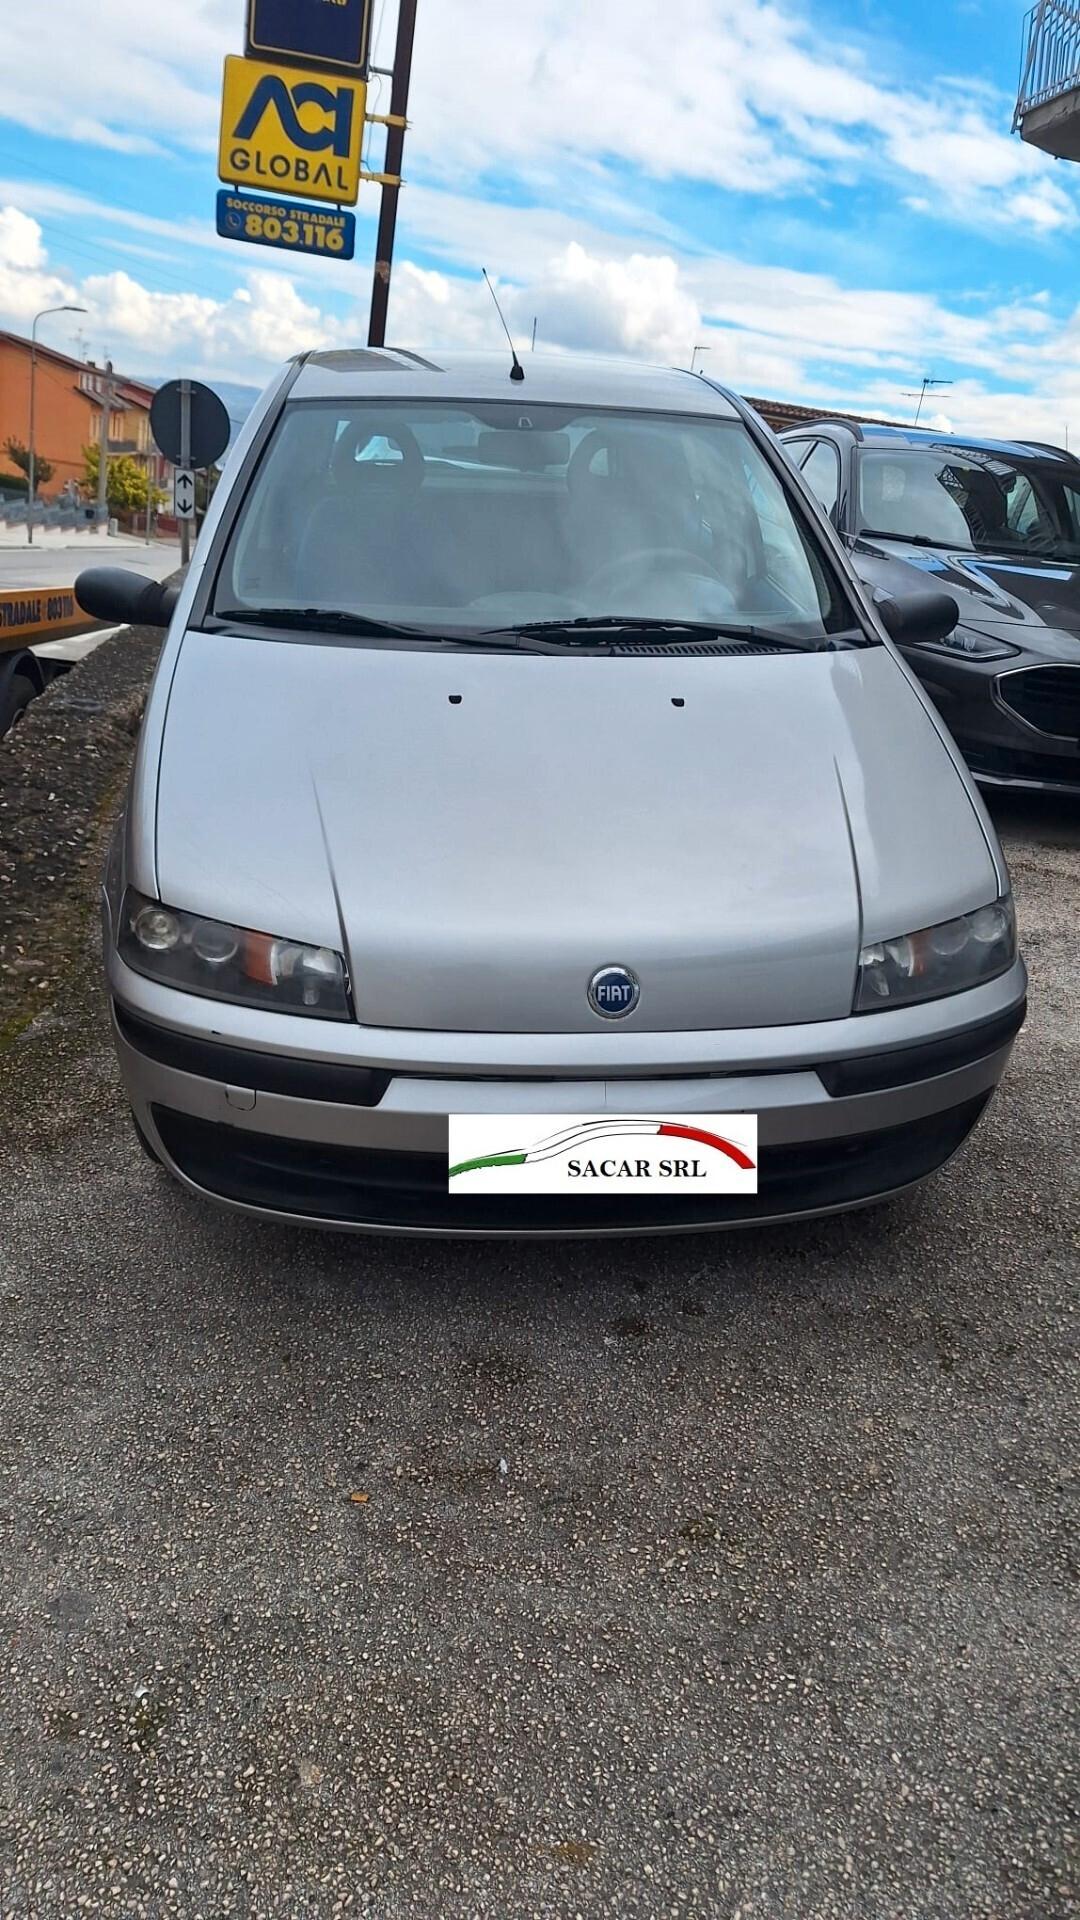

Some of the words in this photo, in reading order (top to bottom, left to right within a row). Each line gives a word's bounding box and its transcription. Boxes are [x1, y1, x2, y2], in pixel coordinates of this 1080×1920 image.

[232, 75, 354, 157] ACI
[230, 148, 349, 191] GLOBAL
[226, 197, 286, 217] SOCCORSO
[289, 208, 346, 228] STRADALE
[245, 214, 344, 250] 803.116
[597, 985, 630, 1002] FIAT
